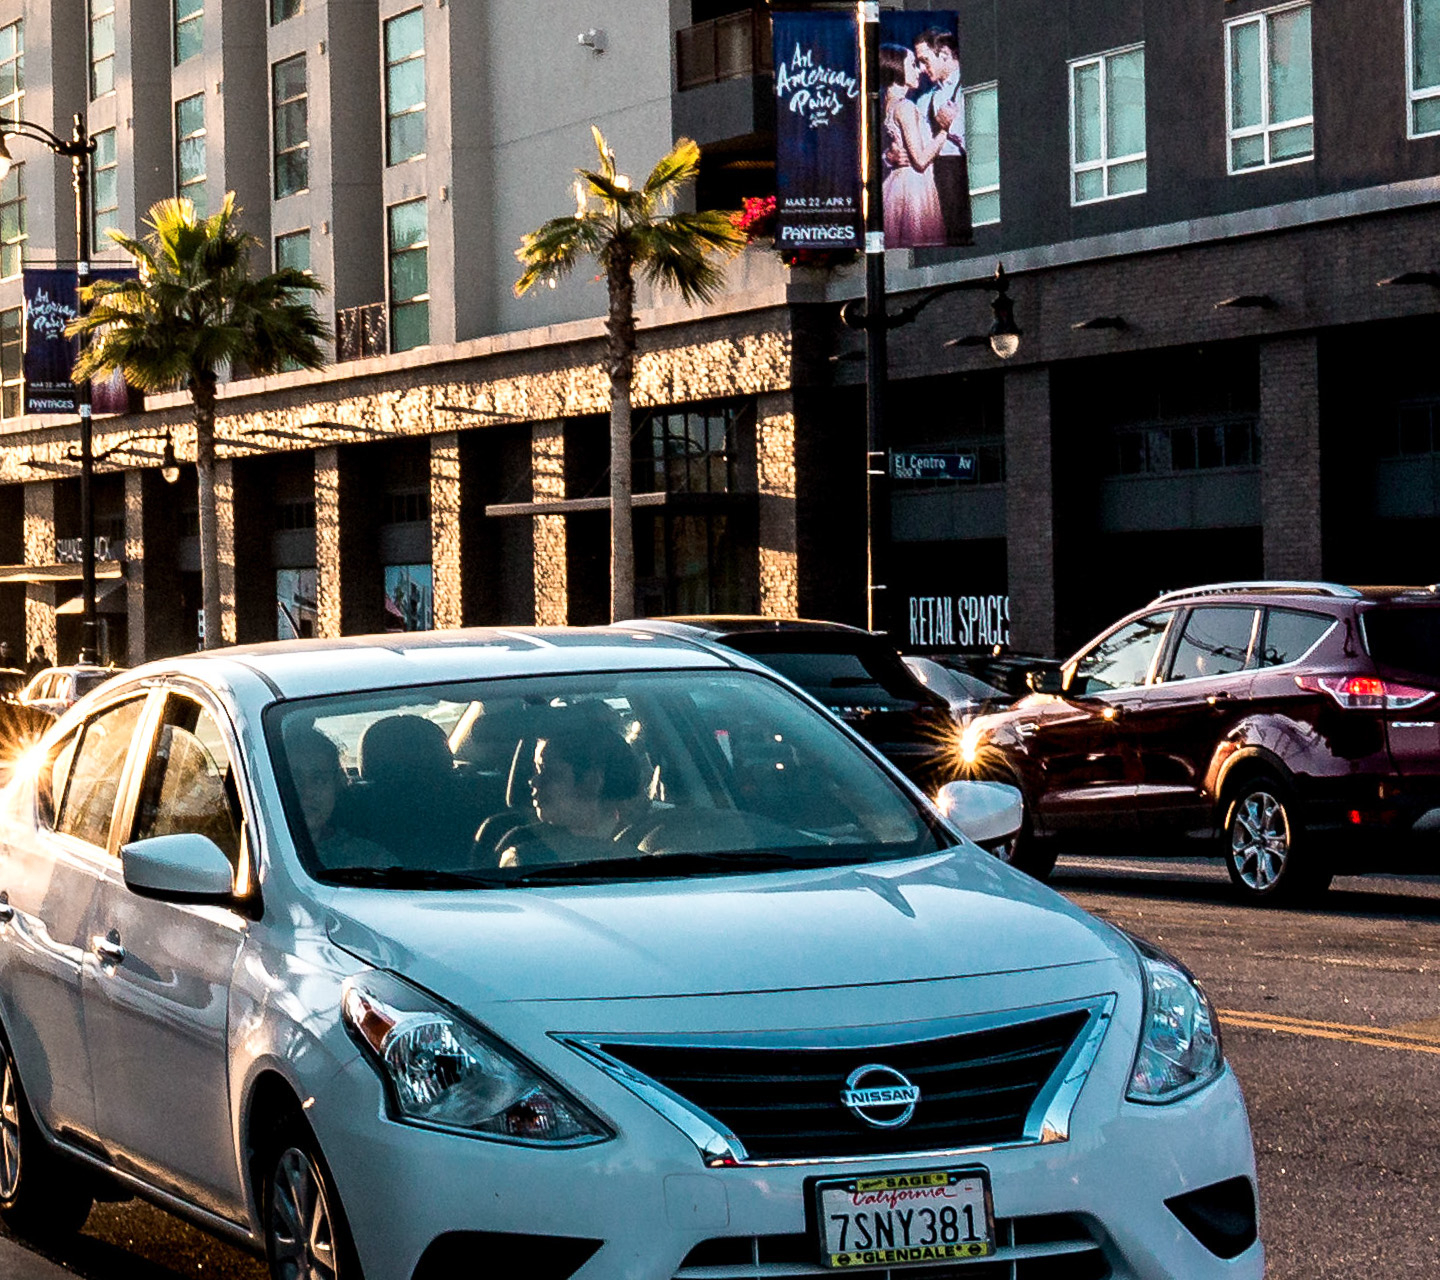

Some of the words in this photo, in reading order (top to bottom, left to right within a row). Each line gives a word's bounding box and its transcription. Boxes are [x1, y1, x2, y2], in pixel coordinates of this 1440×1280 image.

[791, 42, 814, 70] An
[776, 62, 859, 98] American
[789, 89, 844, 116] Paris
[785, 197, 807, 207] MAR
[808, 197, 821, 207] 22
[826, 197, 844, 207] APR
[781, 225, 856, 241] PANTAGES
[27, 301, 76, 319] American
[28, 398, 75, 411] PANTAGES
[895, 456, 905, 469] El
[909, 456, 946, 470] Centro
[958, 456, 972, 470] Av
[909, 597, 956, 646] RETAIL
[851, 1090, 916, 1104] NISSAN
[885, 1174, 931, 1188] SAGE
[851, 1185, 958, 1209] California
[830, 1204, 981, 1251] 7SNY381
[862, 1244, 956, 1264] GLENDALE
